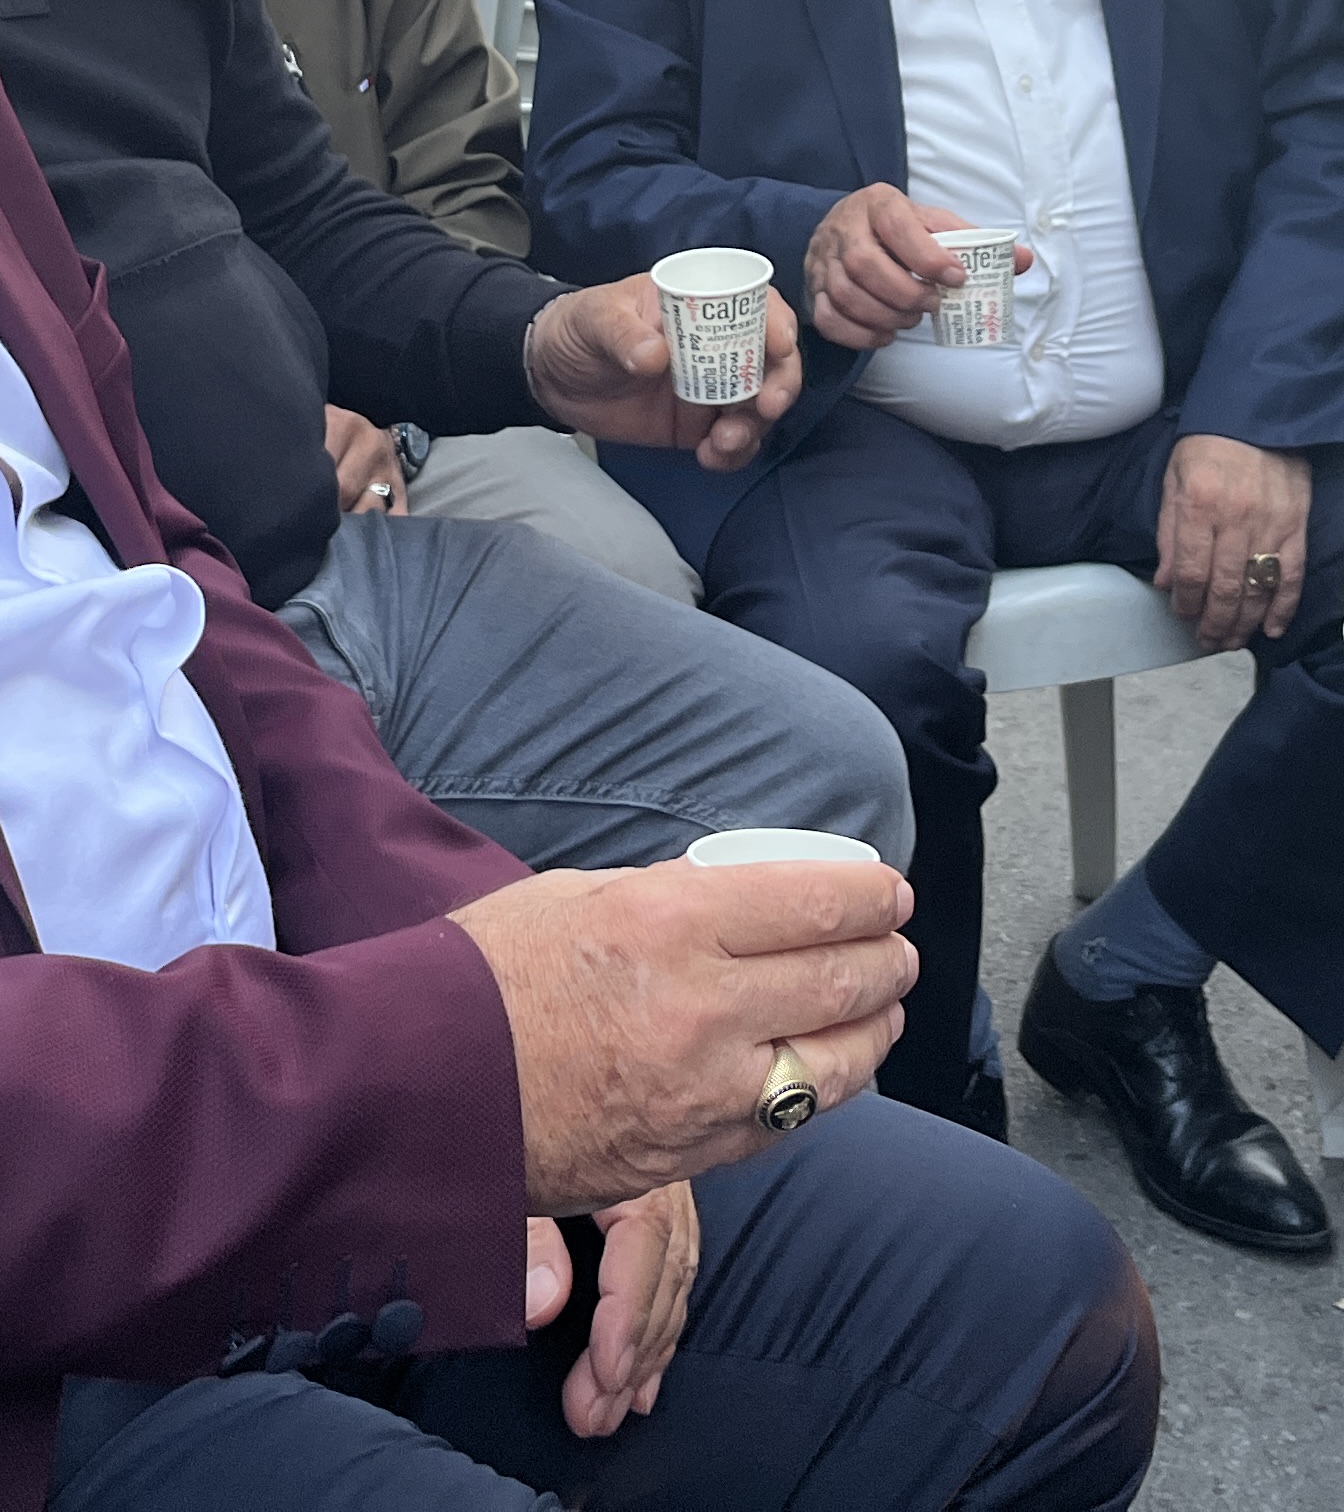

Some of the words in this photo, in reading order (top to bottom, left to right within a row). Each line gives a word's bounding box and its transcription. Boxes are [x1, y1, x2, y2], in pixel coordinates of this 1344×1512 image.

[953, 247, 991, 273] afe
[702, 295, 750, 323] cafe
[672, 304, 685, 350] mocha
[695, 318, 758, 335] espresso
[702, 337, 755, 352] coffee
[729, 351, 741, 399] mocha
[739, 349, 758, 393] coffee
